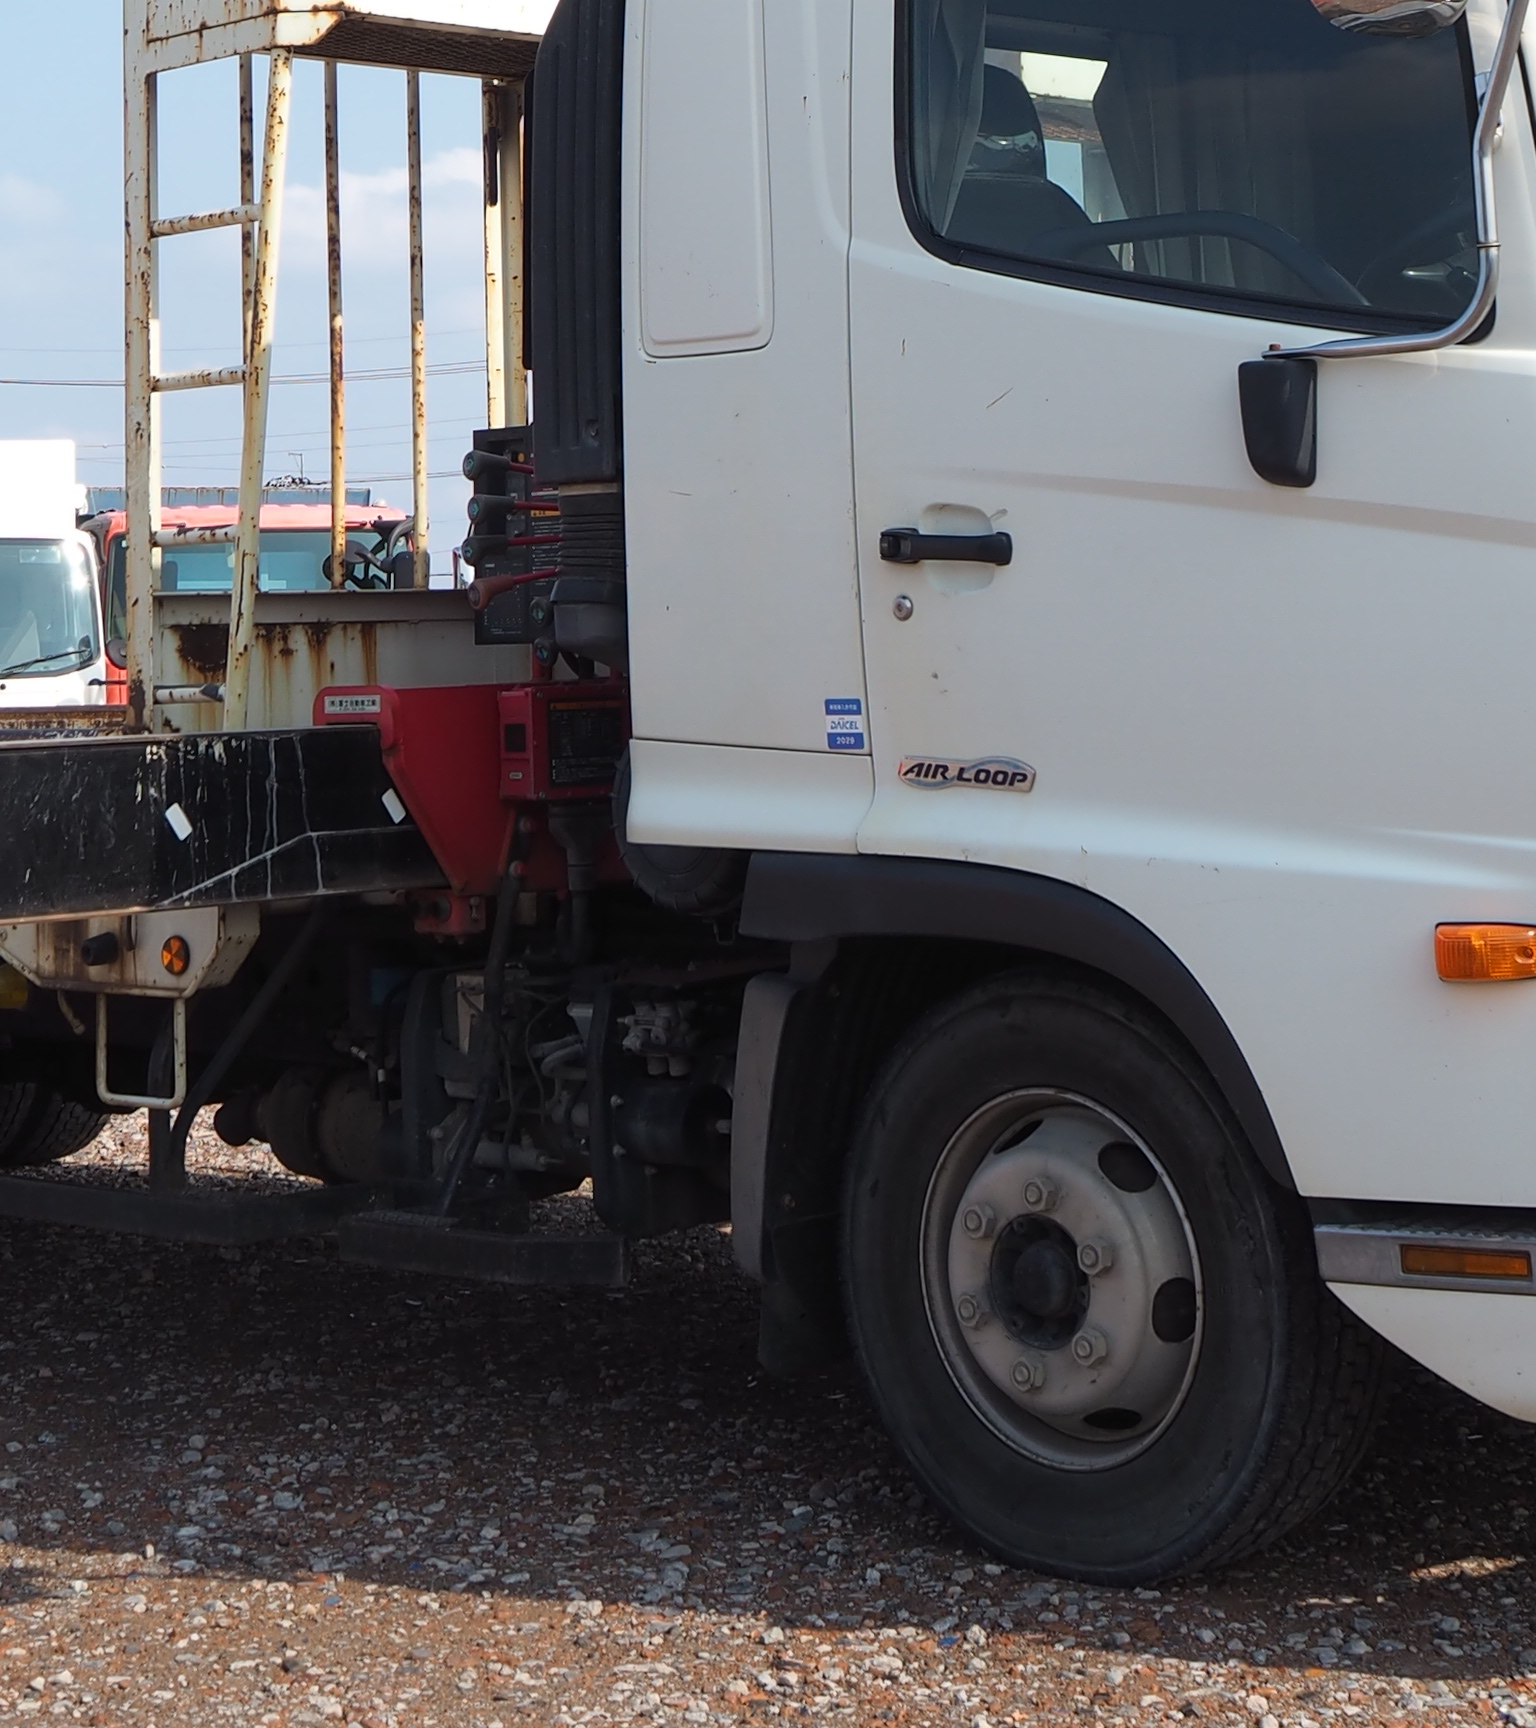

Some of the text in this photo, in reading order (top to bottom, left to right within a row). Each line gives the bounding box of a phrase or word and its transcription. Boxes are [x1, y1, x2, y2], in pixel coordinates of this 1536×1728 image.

[830, 720, 859, 730] DAICEL
[902, 762, 1029, 787] AIR LOOP
